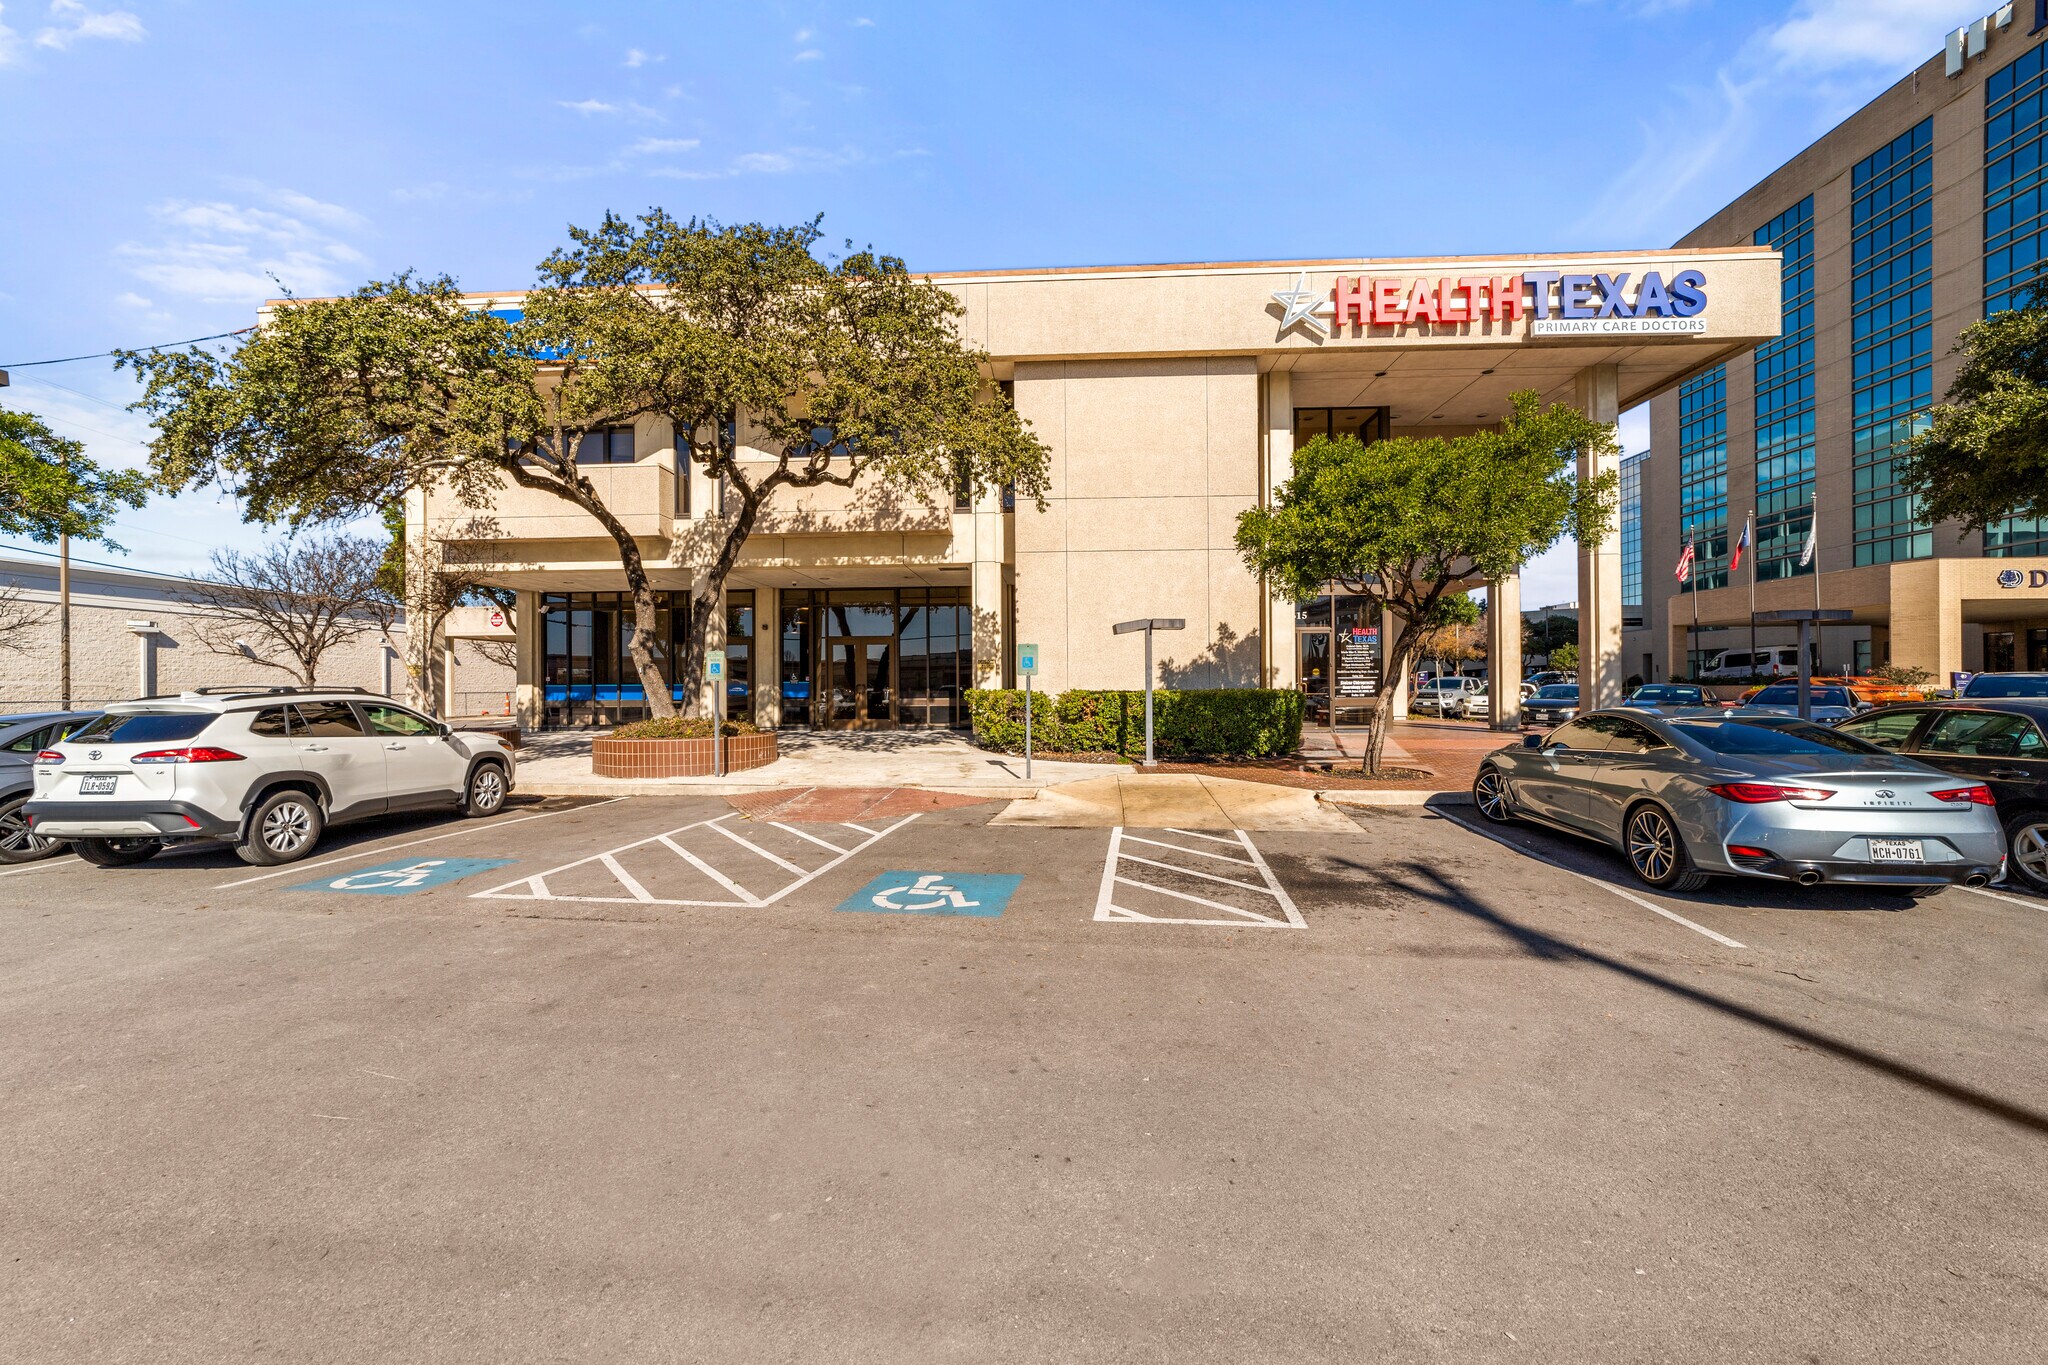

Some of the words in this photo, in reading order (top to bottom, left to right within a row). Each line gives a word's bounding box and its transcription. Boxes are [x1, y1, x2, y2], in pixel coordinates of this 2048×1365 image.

[1537, 321, 1598, 332] PRIMARY
[1602, 321, 1637, 331] CARE
[1641, 320, 1705, 331] DOCTORS
[1352, 627, 1378, 635] HEALTH
